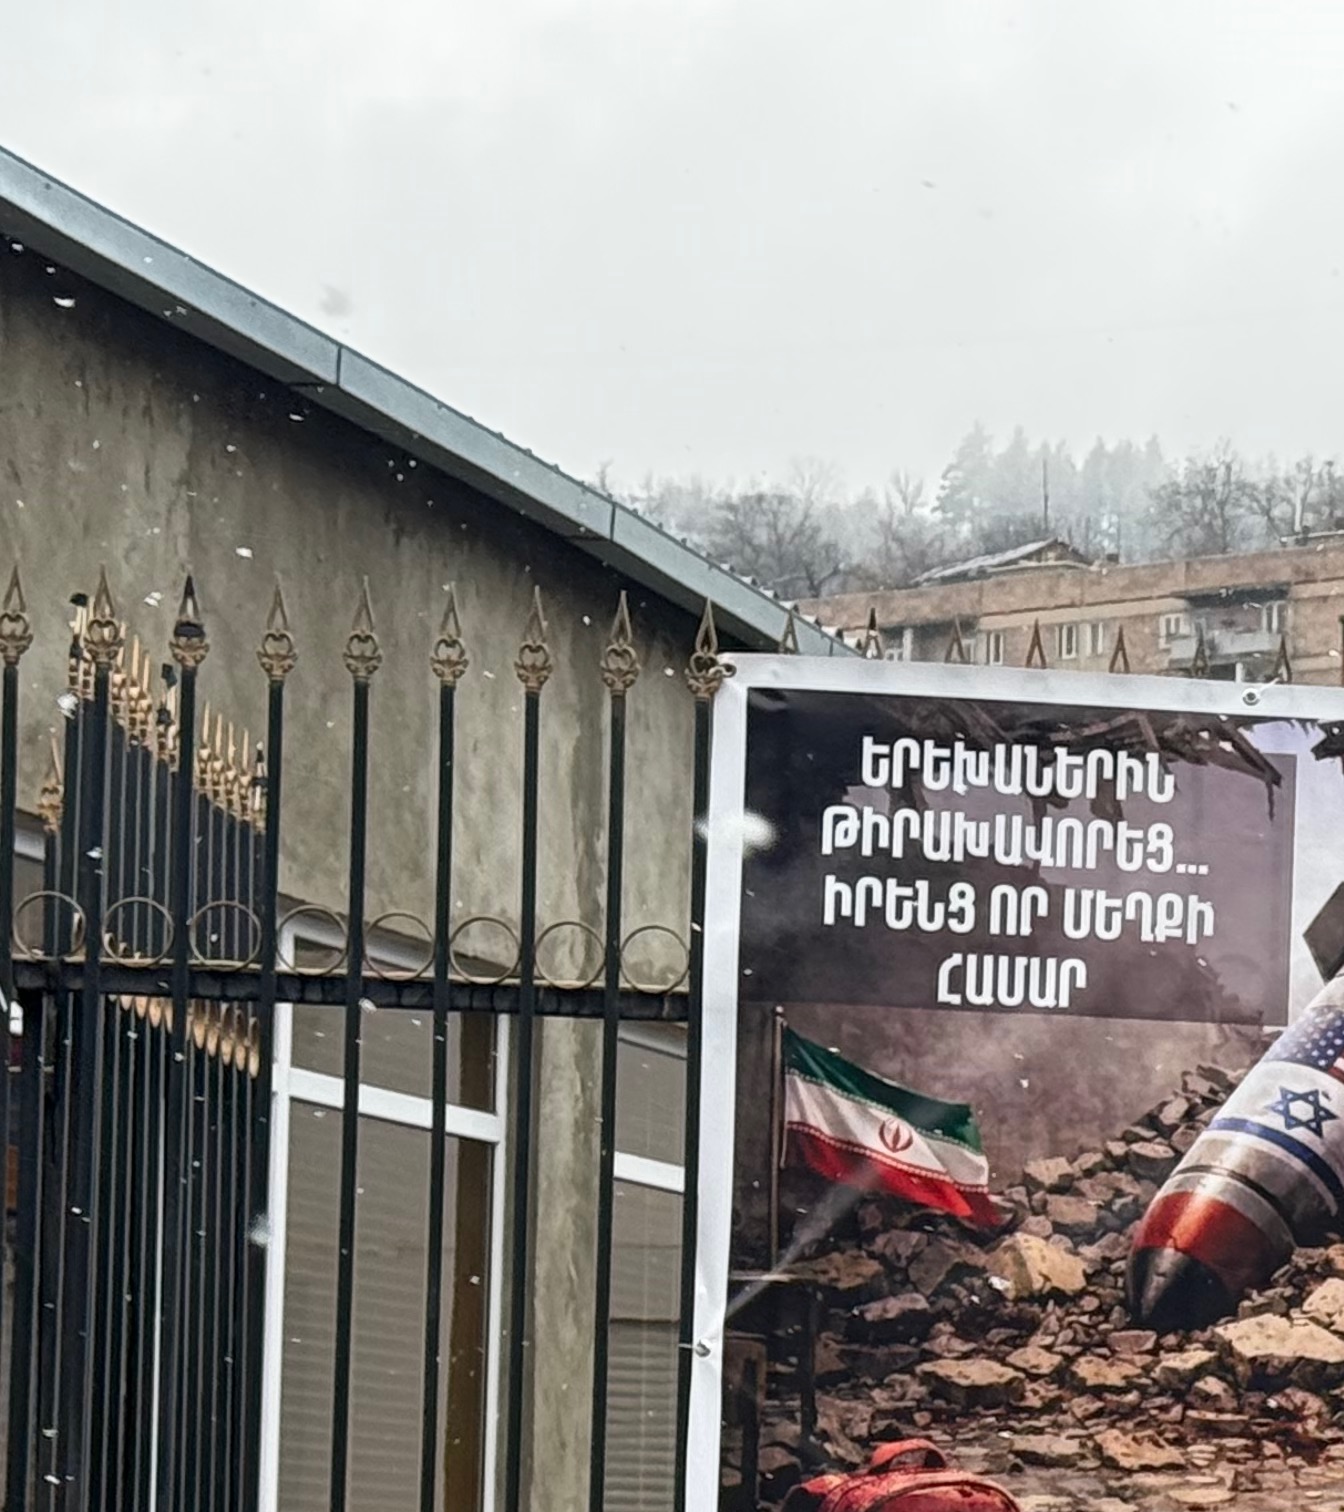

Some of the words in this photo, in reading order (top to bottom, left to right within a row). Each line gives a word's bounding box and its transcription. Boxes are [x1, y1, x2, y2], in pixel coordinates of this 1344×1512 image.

[861, 734, 1176, 803] ԵՐԵԽԱՆԵՐԻՆ
[820, 804, 1210, 876] ԹԻՐԱԽԱՎՈՐԵՑ...
[822, 873, 977, 934] ԻՐԵՆՑ
[988, 883, 1049, 937] ՈՐ
[1062, 886, 1215, 945] ՄԵՂՔԻ
[936, 951, 1088, 1009] ՀԱՄԱՐ
